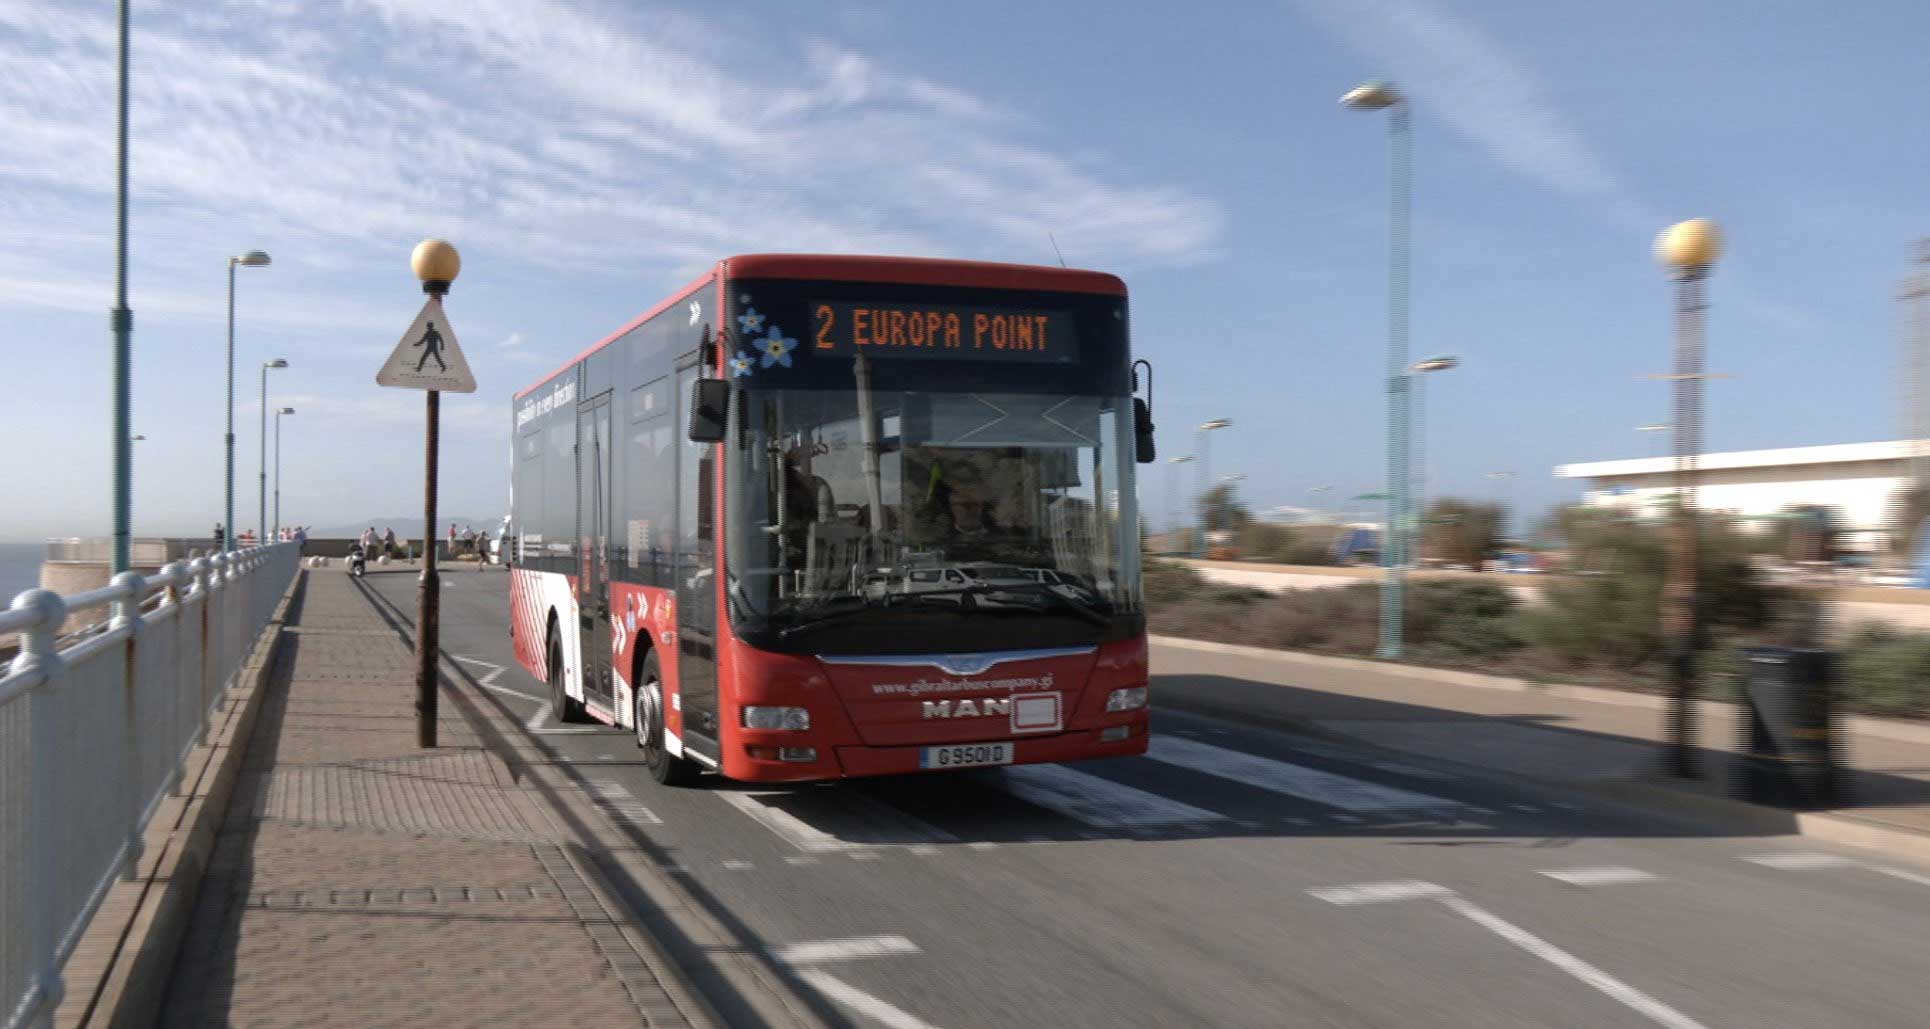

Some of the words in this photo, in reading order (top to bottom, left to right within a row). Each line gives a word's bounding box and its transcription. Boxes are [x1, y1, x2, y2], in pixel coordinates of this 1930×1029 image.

[815, 304, 835, 349] 2
[852, 308, 961, 348] EUROPA
[973, 313, 1048, 351] POINT
[921, 698, 1011, 718] MAN
